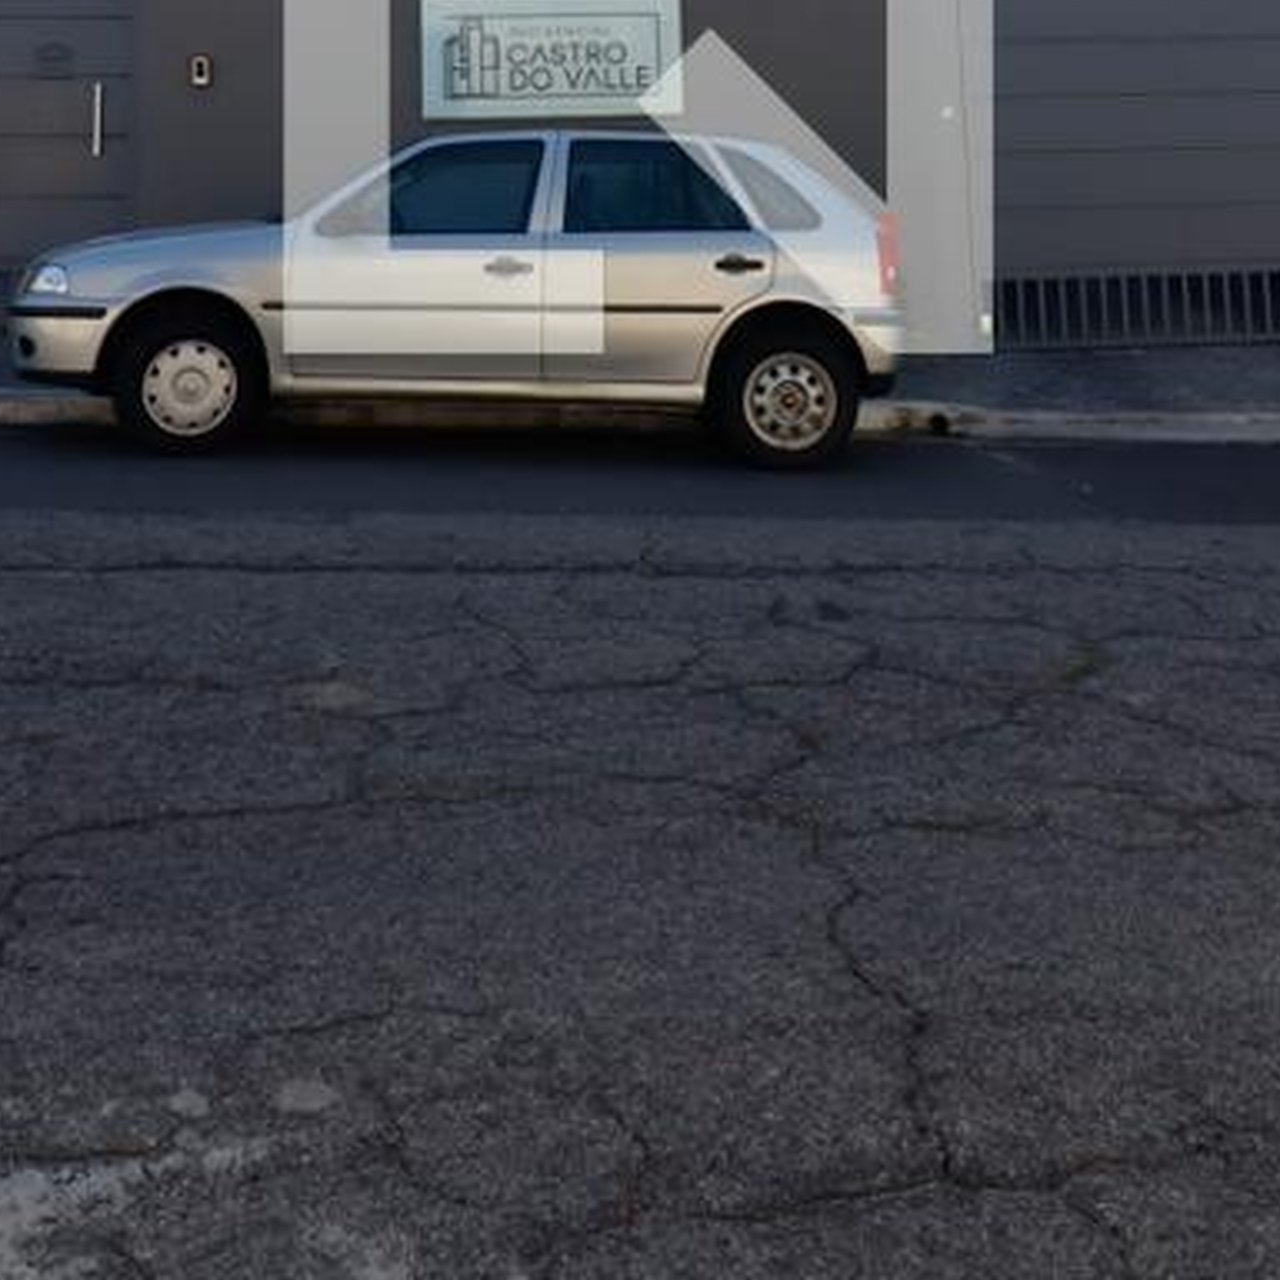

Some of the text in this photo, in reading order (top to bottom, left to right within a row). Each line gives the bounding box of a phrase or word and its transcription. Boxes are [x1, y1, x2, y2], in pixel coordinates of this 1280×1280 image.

[507, 41, 628, 66] CASTRO
[509, 65, 653, 91] DO VALLE
